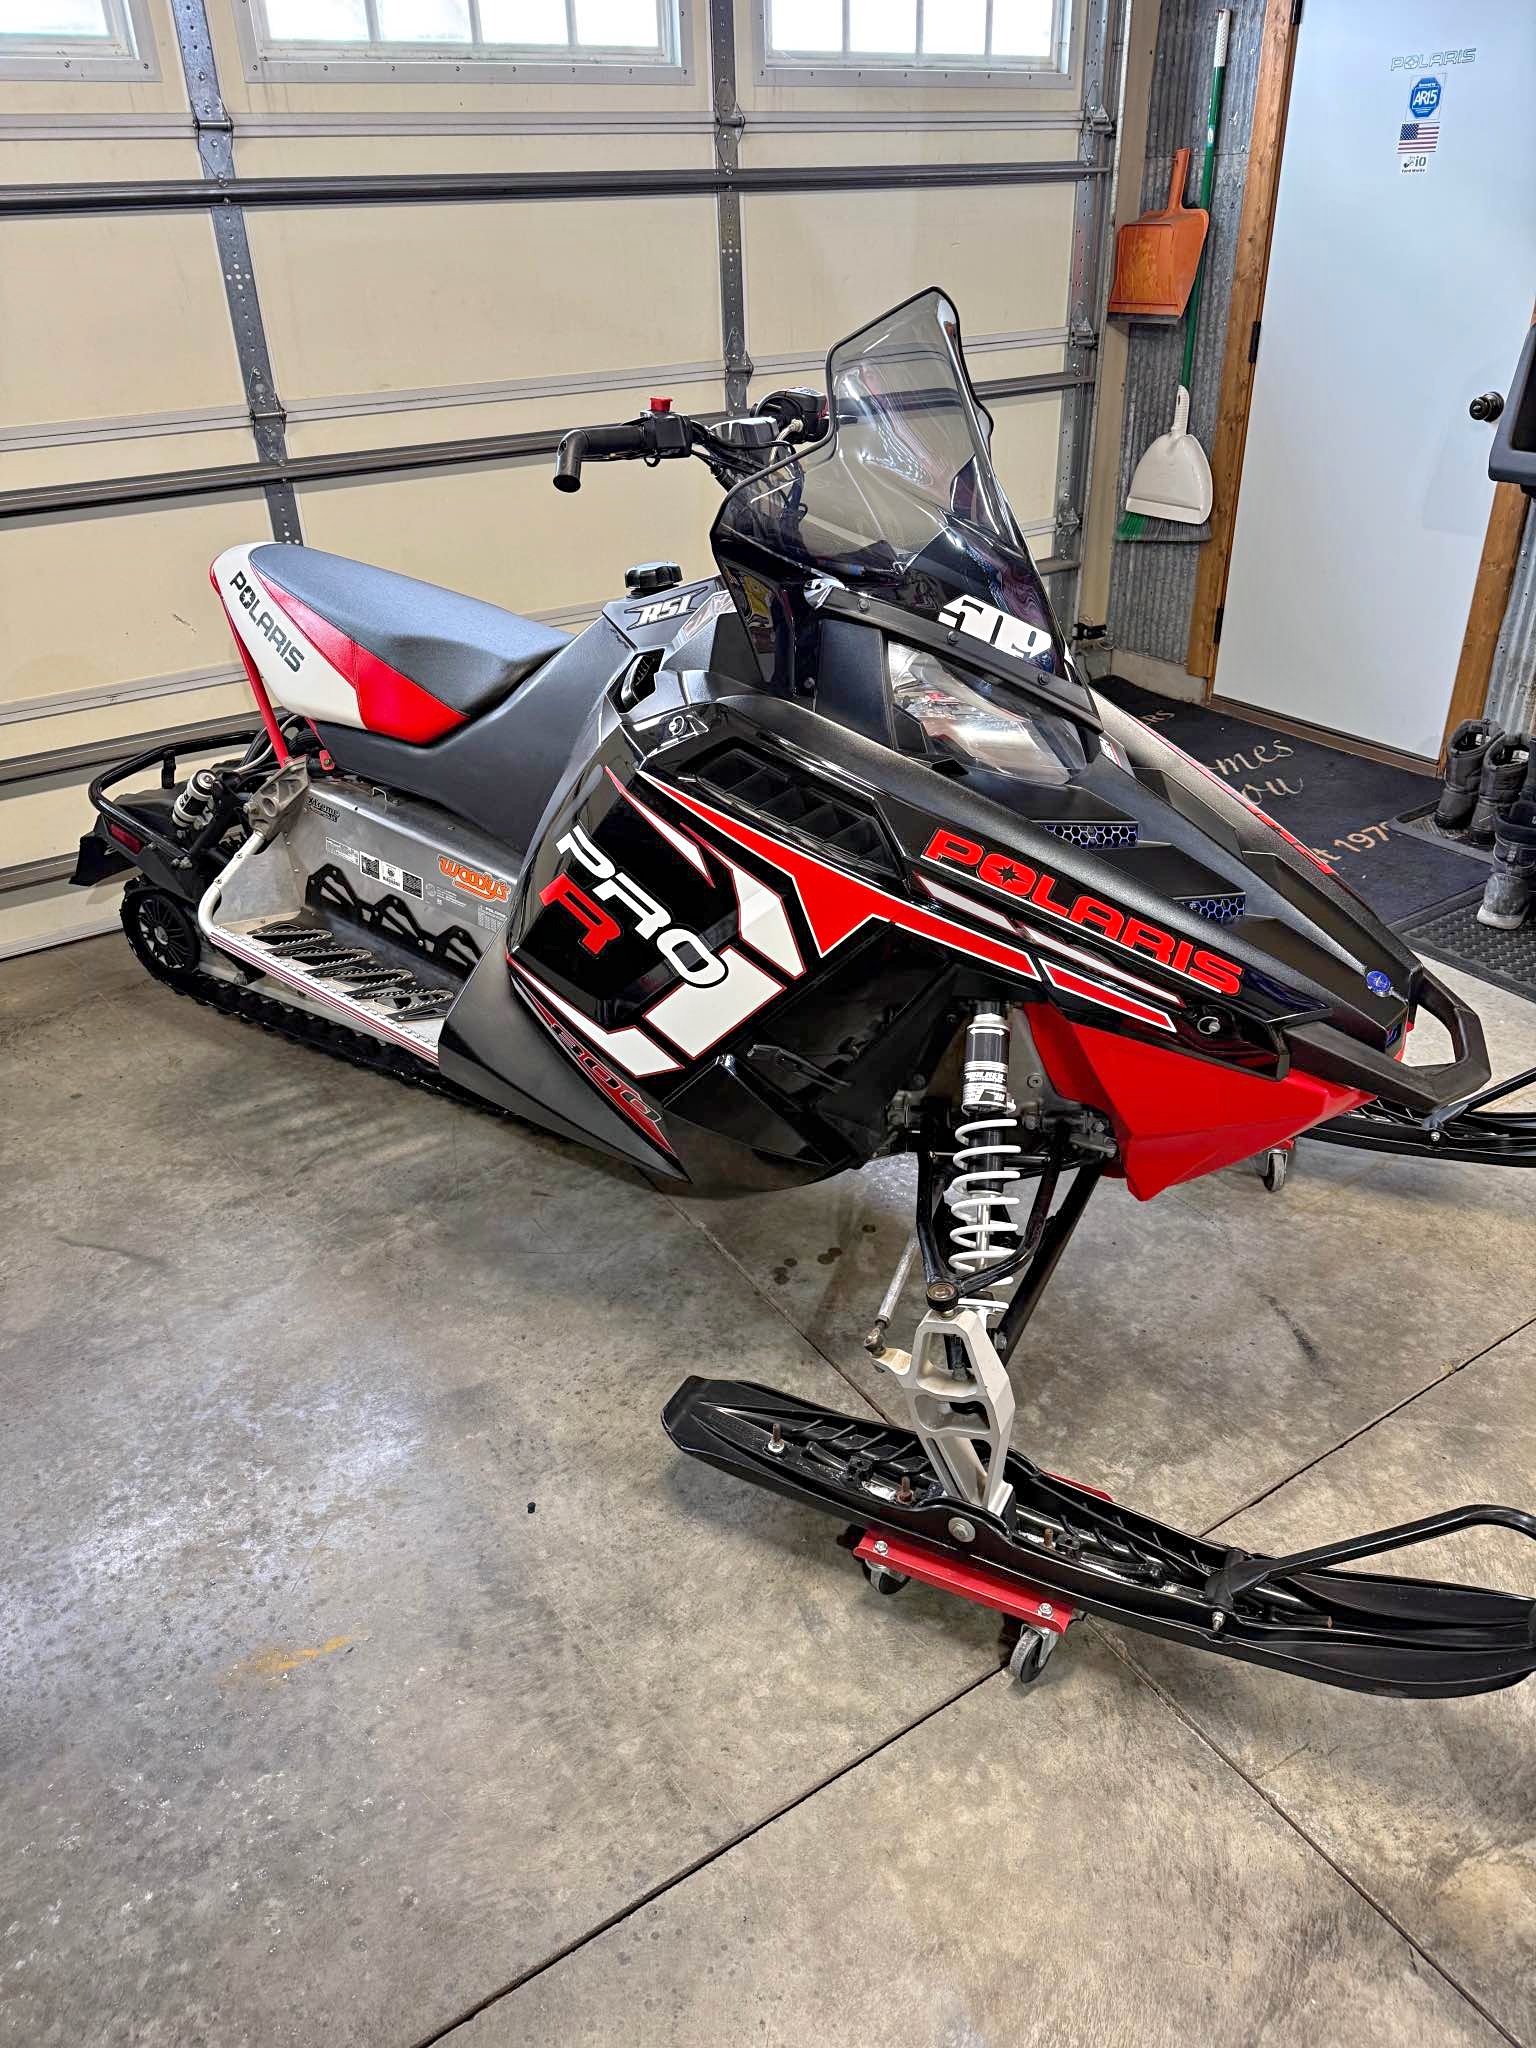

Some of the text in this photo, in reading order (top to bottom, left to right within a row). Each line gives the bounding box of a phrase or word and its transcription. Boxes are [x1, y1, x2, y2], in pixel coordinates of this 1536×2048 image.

[1390, 48, 1477, 71] POLARIS
[1412, 89, 1438, 106] AR15
[229, 570, 304, 672] POLARIS
[938, 594, 1052, 660] 509
[1240, 778, 1303, 805] ou
[539, 872, 622, 955] R
[556, 824, 729, 988] PRO
[922, 828, 1244, 996] POLARIS
